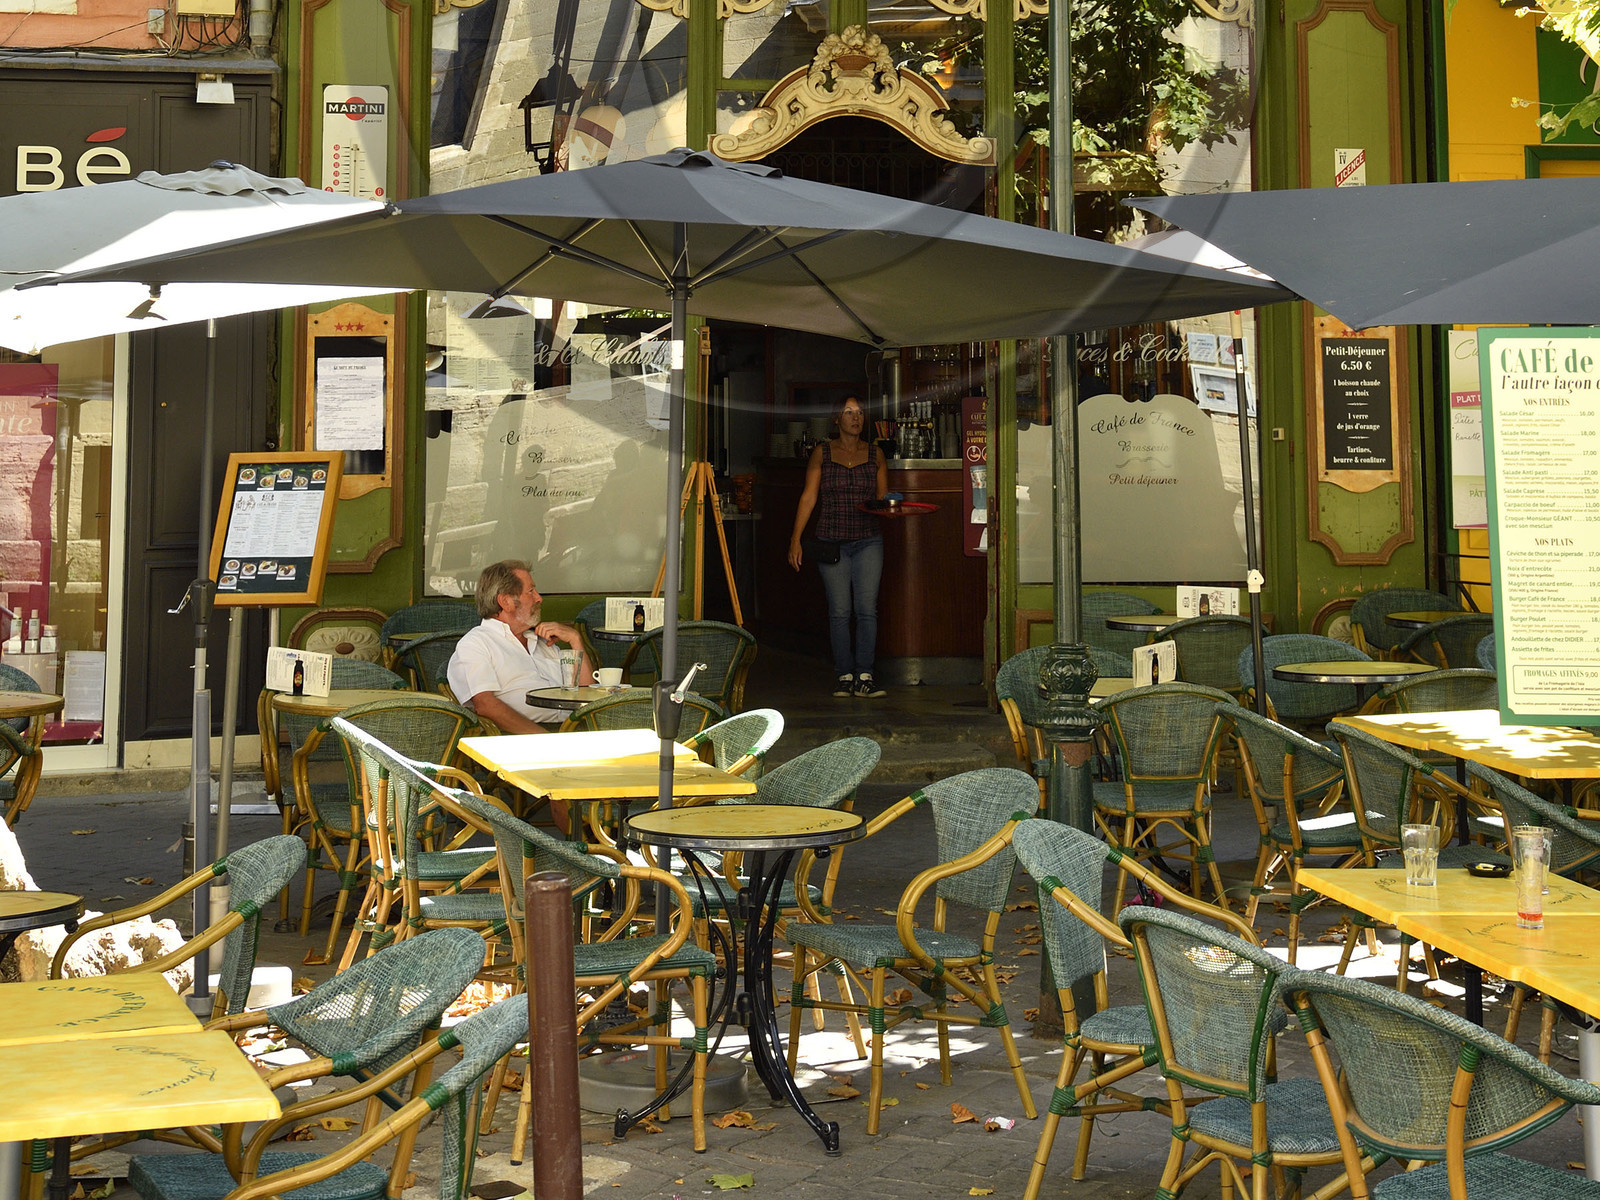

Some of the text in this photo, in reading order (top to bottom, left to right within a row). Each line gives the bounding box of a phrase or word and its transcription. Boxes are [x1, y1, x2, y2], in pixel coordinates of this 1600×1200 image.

[328, 103, 383, 114] MARTINI
[1335, 152, 1365, 185] LICENCE
[1111, 341, 1134, 363] &
[1325, 345, 1386, 358] Petit-Déjeuner
[1501, 341, 1593, 373] CAFÉ de
[1340, 360, 1372, 371] 6.50 €
[1337, 379, 1359, 387] boisson
[1360, 379, 1381, 387] chaude
[1502, 375, 1591, 393] l'autre façon
[1456, 395, 1475, 404] PLAT
[1523, 397, 1570, 406] NOS ENTRÉES
[1090, 410, 1197, 437] Café de France
[1336, 422, 1380, 431] de jus d'orange
[1117, 440, 1170, 453] Brasserie
[1333, 456, 1387, 464] beurre & confiture
[1108, 472, 1179, 487] Petit déjeuner
[521, 485, 548, 498] Plat
[1535, 538, 1574, 546] NOS PLATS
[1523, 669, 1557, 678] FROMAGES
[1585, 669, 1598, 678] 9,00
